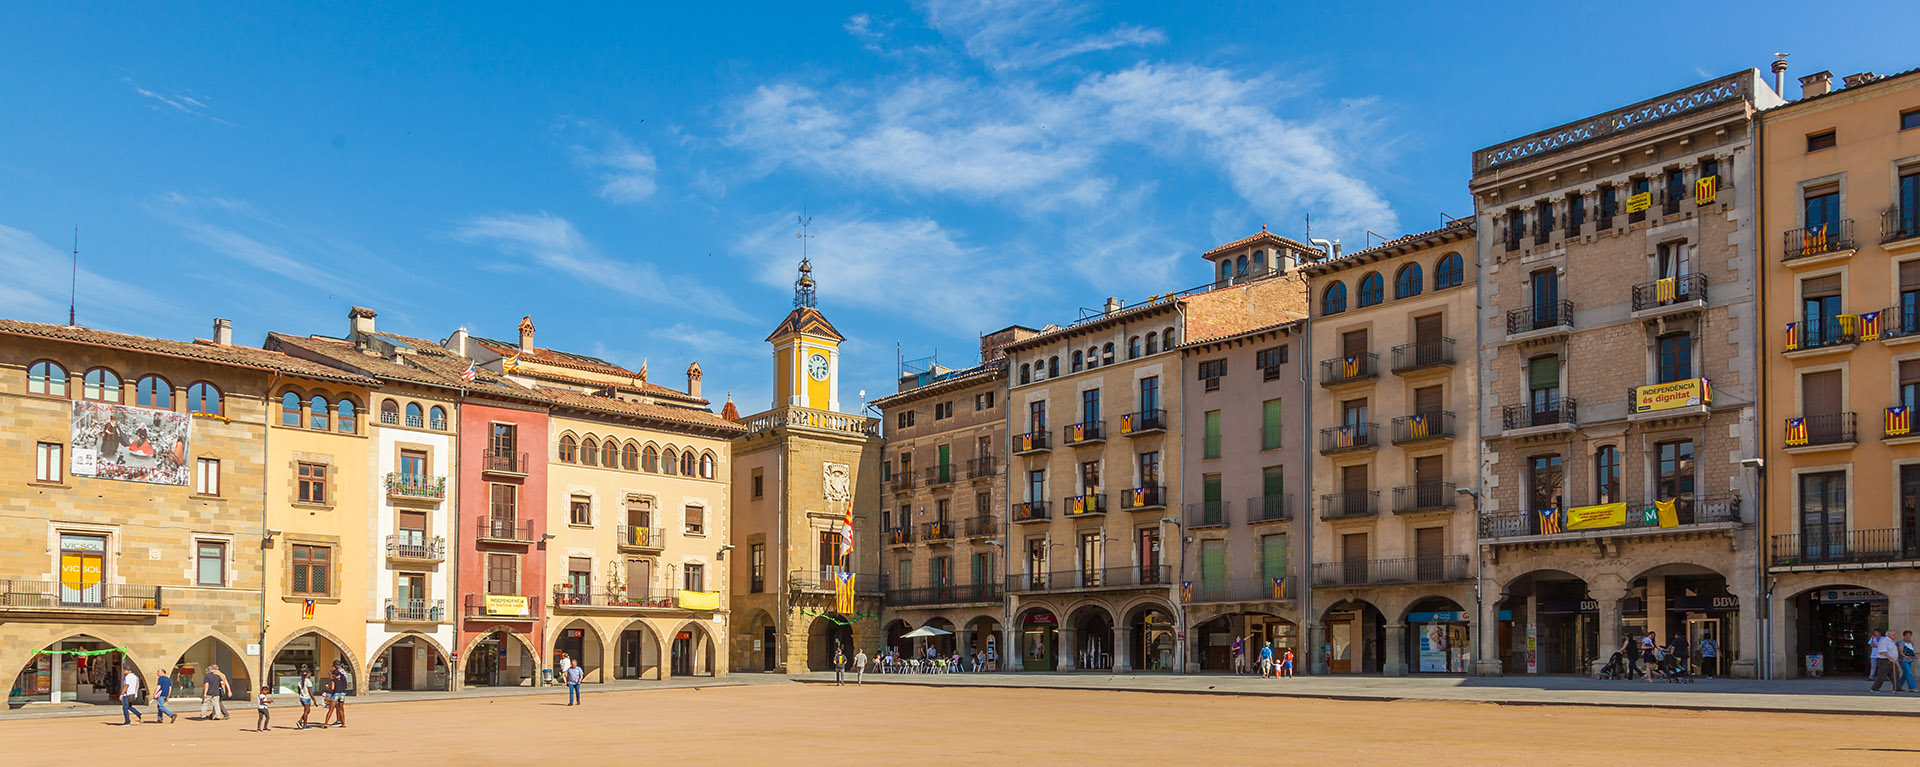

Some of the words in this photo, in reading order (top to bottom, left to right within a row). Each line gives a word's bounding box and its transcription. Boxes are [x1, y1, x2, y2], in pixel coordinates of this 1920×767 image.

[1642, 383, 1695, 396] INDEPENDÈNCIA
[1643, 396, 1653, 404] és
[1655, 391, 1690, 403] dignitat
[1645, 510, 1657, 522] M
[64, 542, 100, 550] VICSOL
[61, 565, 102, 573] VICSOL
